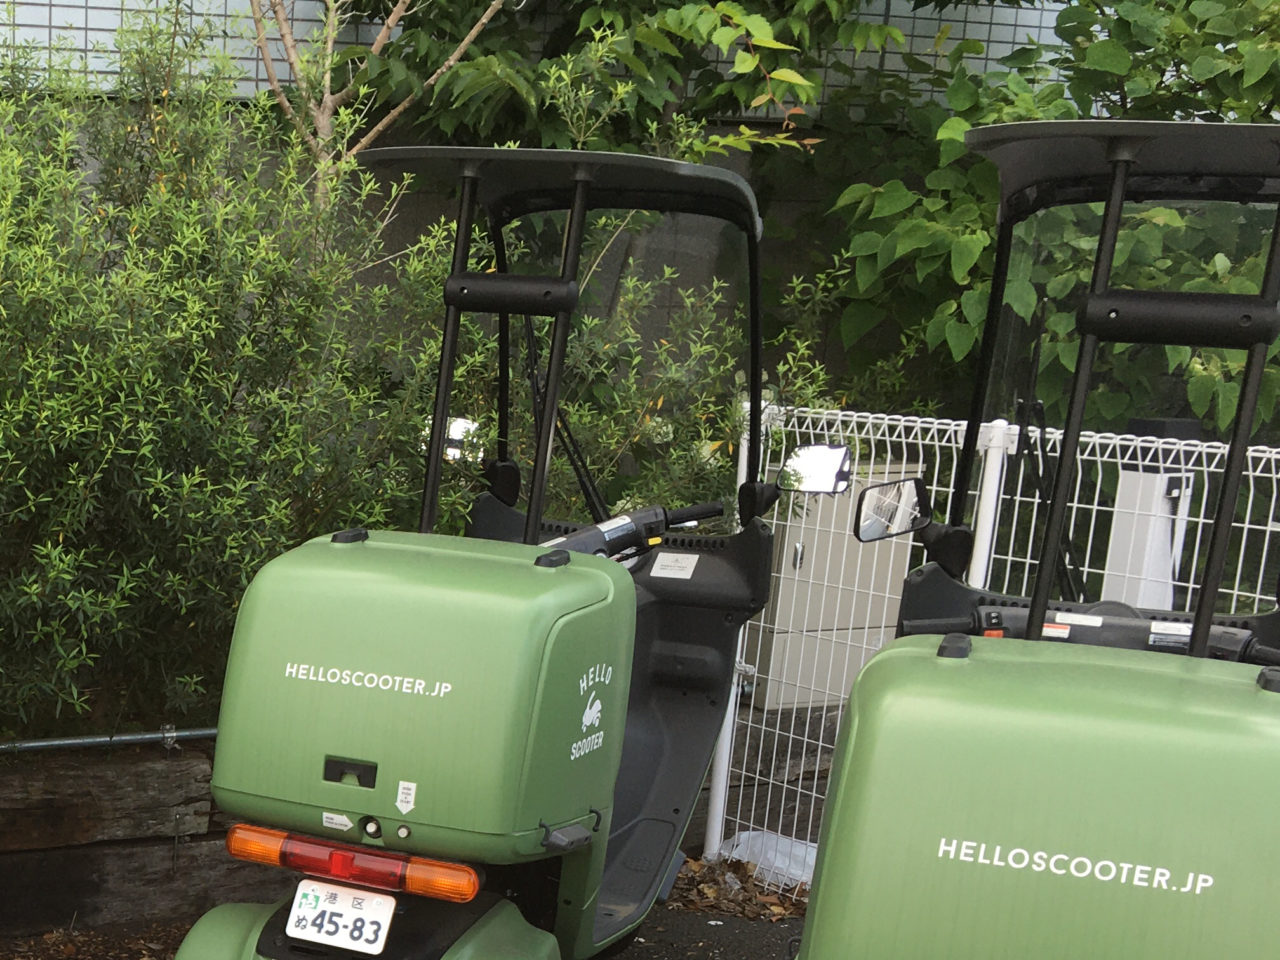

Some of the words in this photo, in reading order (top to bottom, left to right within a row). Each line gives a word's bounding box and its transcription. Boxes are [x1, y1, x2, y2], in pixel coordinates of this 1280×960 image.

[285, 662, 452, 698] HELLOSCOOTER.JP
[580, 663, 613, 696] HELLO
[570, 730, 605, 761] SCOOTER
[938, 837, 1215, 896] HELLOSCOOTER.JP
[310, 909, 382, 945] 45-83
